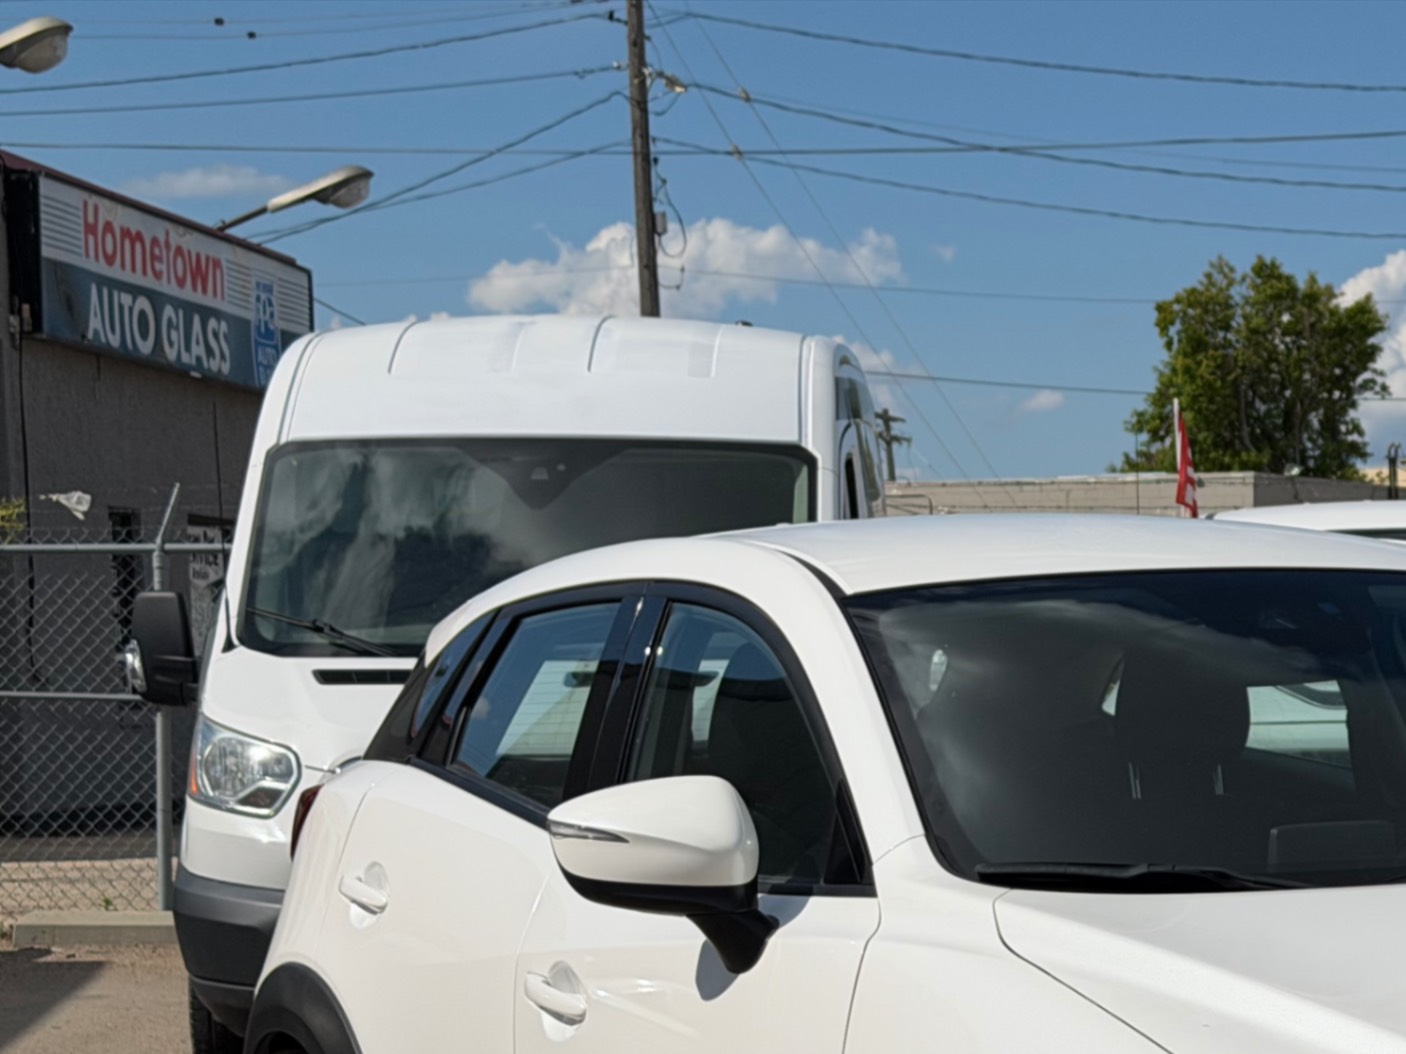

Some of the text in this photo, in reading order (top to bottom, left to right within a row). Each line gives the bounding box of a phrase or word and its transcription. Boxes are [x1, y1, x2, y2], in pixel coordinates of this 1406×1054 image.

[82, 200, 225, 301] Hometown
[87, 282, 231, 375] AUTO GLASS
